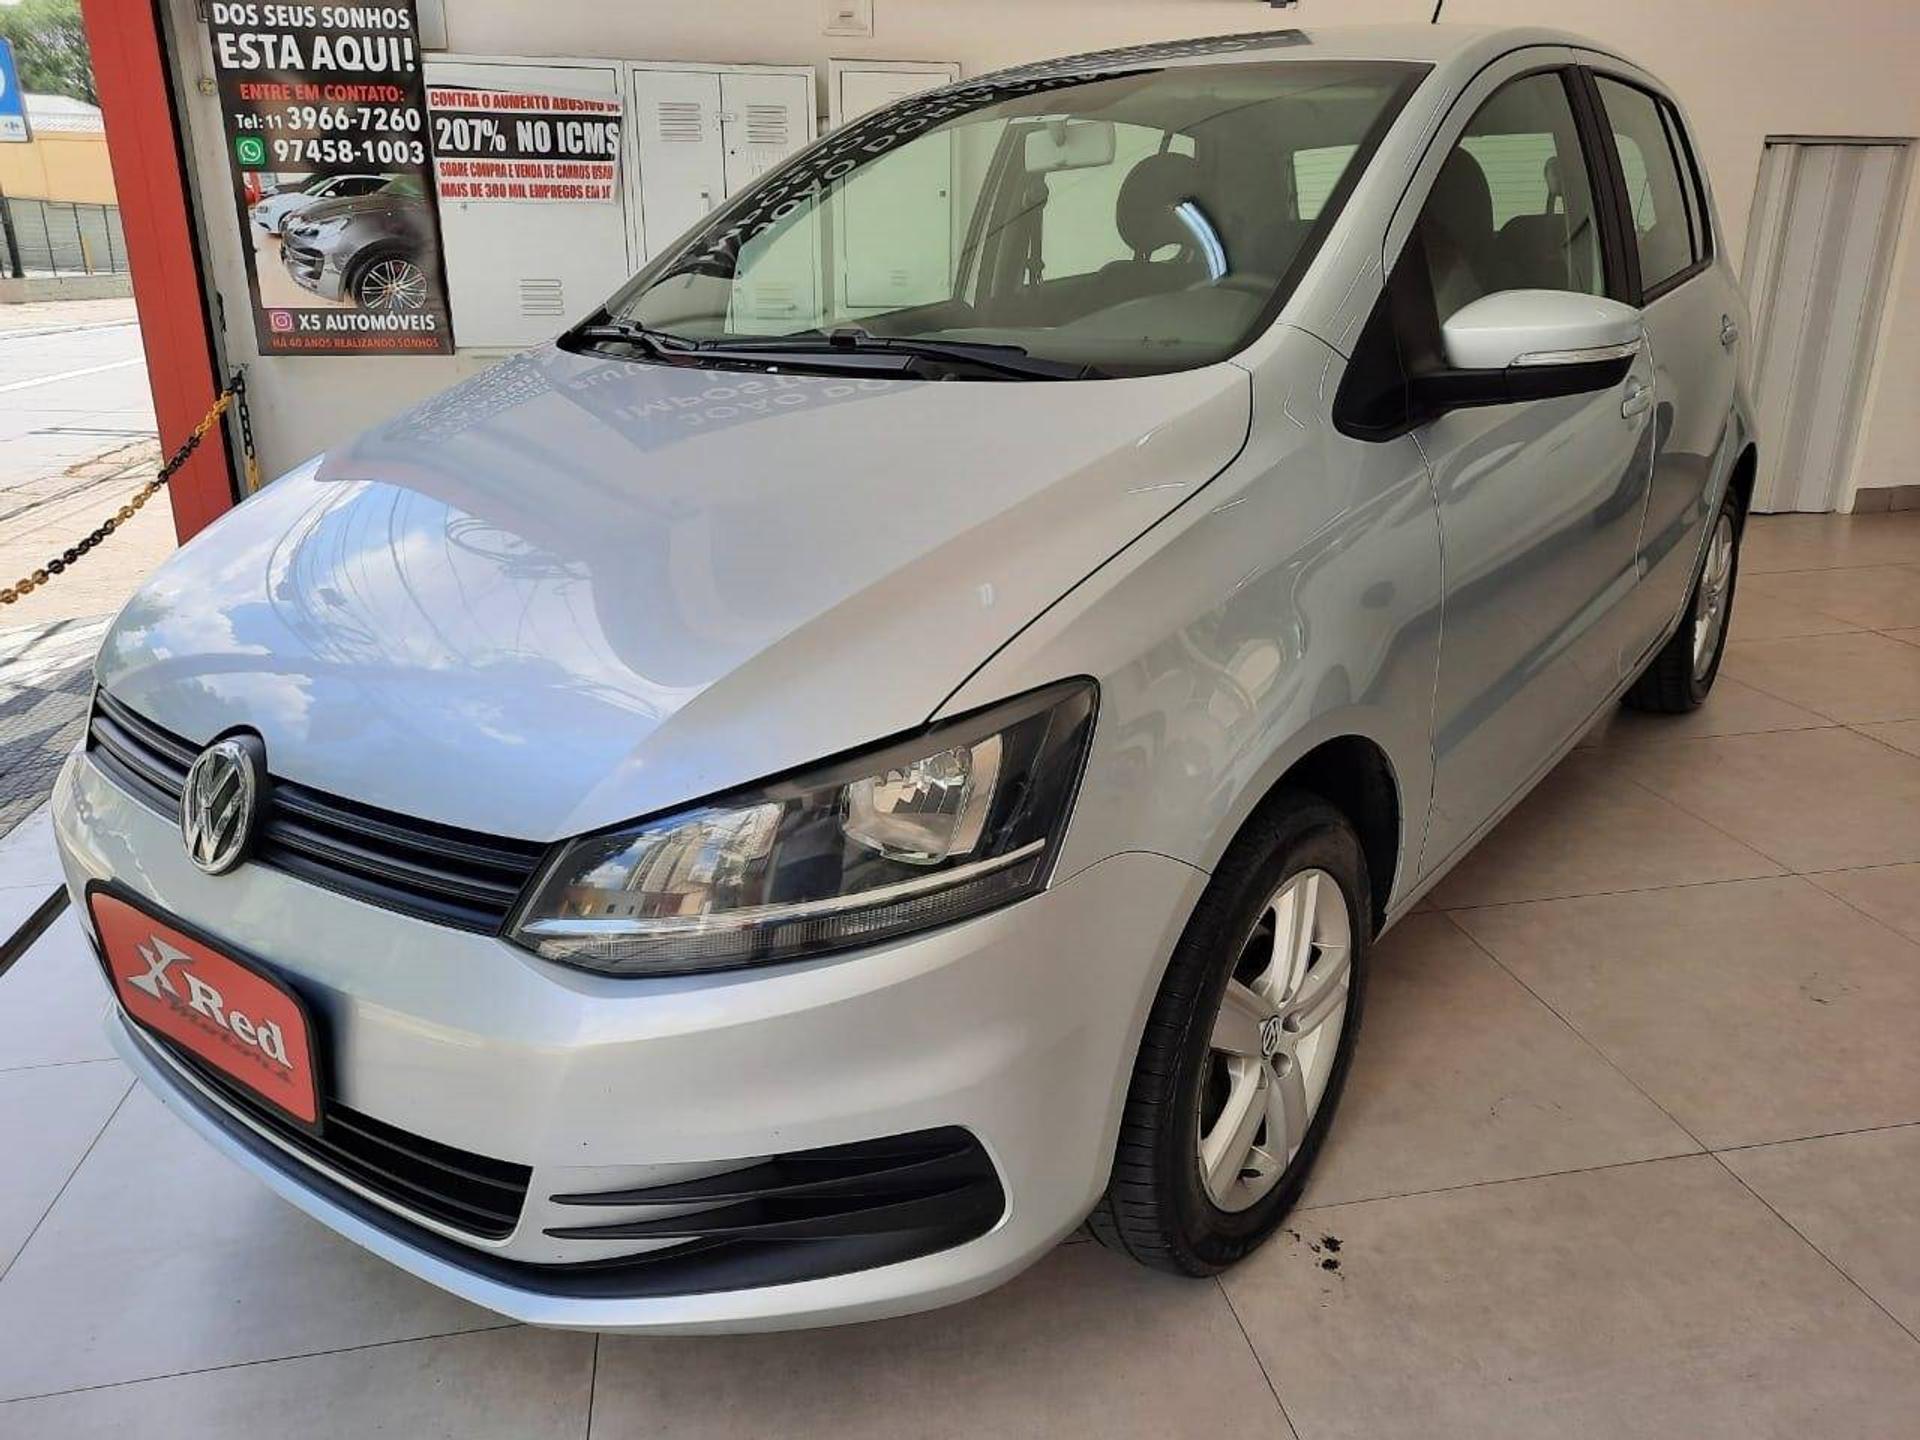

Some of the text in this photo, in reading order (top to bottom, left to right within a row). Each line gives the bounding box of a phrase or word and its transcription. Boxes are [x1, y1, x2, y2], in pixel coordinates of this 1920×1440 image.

[212, 3, 411, 30] DOS SEUS SONHOS
[217, 33, 416, 72] ESTA AQUI!
[239, 83, 405, 102] ENTRE EM CONTATO:
[431, 92, 479, 107] CONTRA
[482, 94, 490, 108] O
[493, 94, 550, 110] AUMENTO
[235, 106, 421, 132] Tel: 11 3966-7260
[436, 117, 620, 155] 207% NO ICMS
[274, 139, 425, 165] 97458-1003
[440, 162, 469, 177] SOBRE
[470, 162, 507, 178] COMPRA
[508, 163, 514, 178] E
[514, 163, 543, 179] VENDA
[543, 164, 556, 179] DE
[556, 165, 591, 180] CARROS
[441, 183, 468, 198] MAIS
[469, 183, 483, 198] DE
[484, 184, 507, 198] 300
[508, 184, 527, 199] MIL
[529, 184, 583, 200] EMPREGOS
[585, 185, 600, 200] EM
[299, 311, 436, 332] X5 AUTOMÓVEIS
[181, 968, 294, 1071] Red
